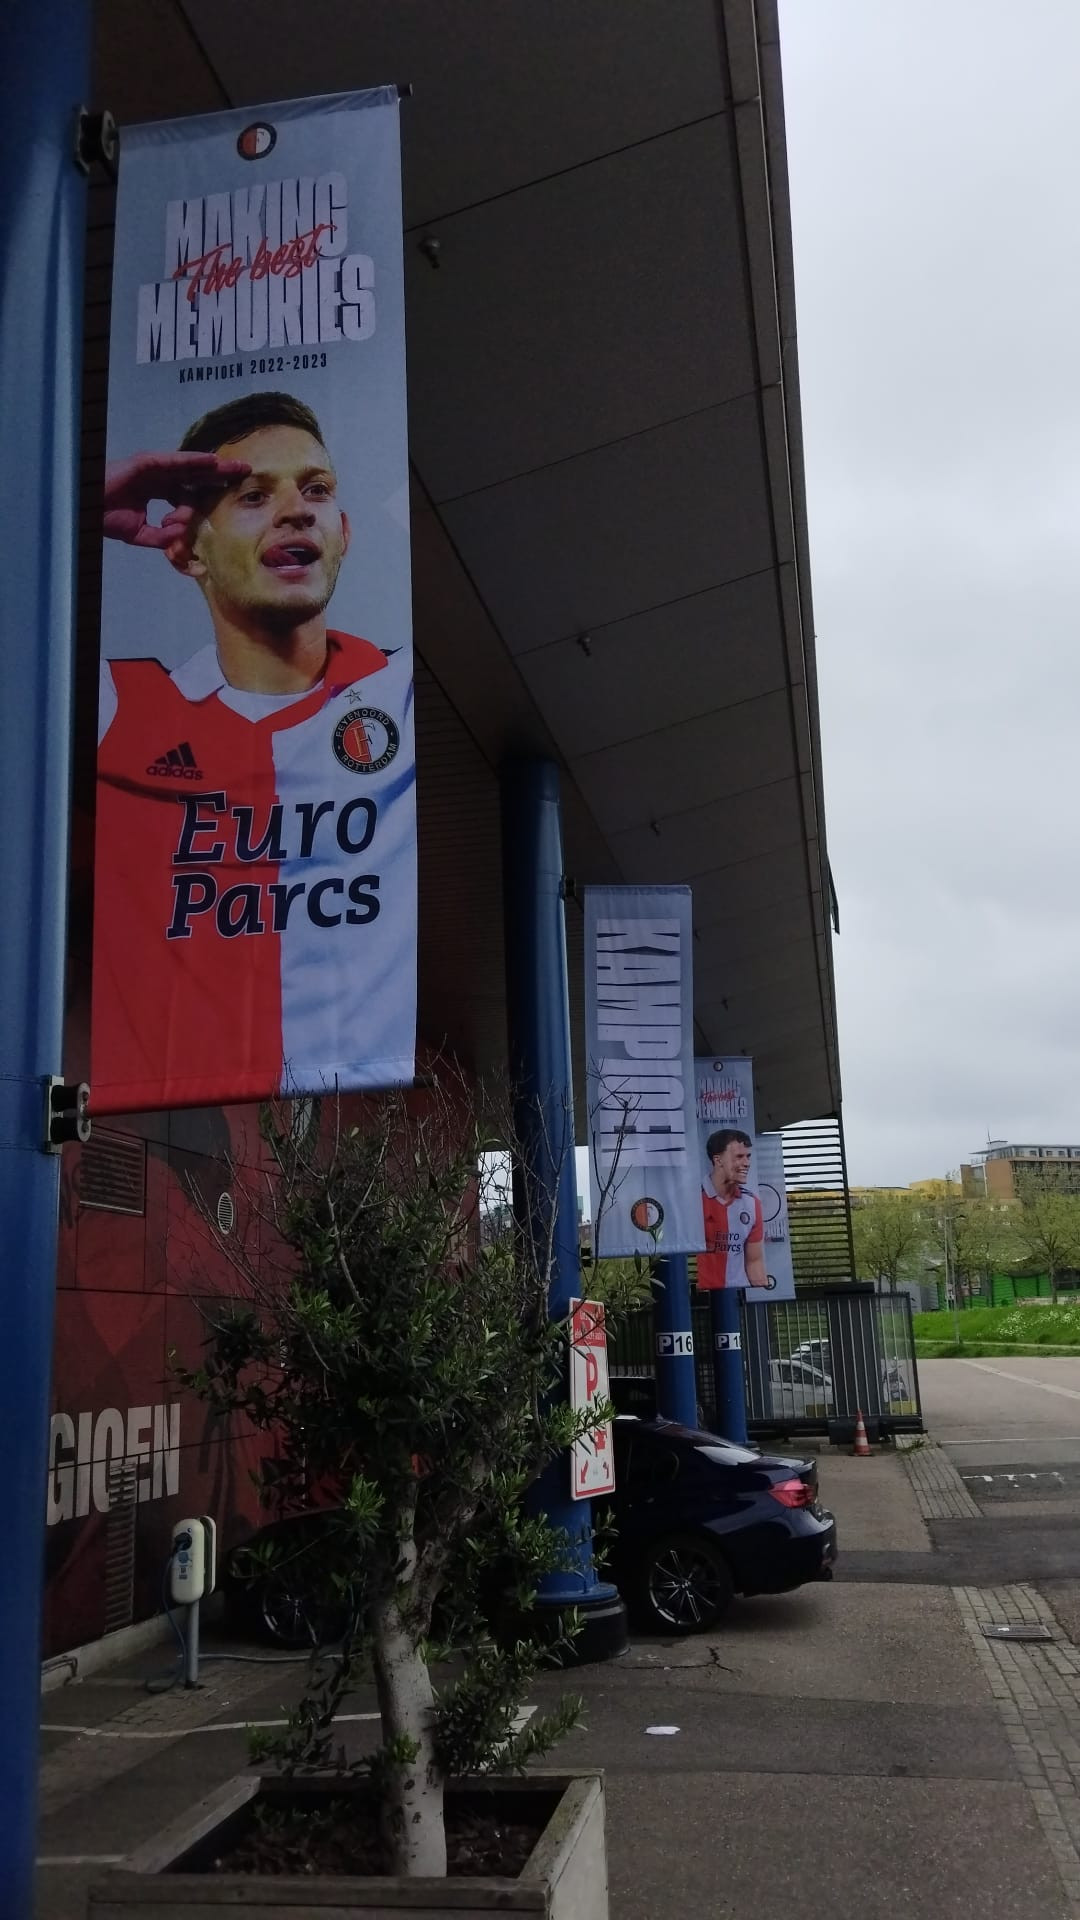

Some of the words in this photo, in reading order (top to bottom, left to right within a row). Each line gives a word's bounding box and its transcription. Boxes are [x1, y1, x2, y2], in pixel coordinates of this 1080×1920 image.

[165, 171, 348, 280] MAKING
[173, 242, 243, 302] The
[249, 223, 338, 280] best
[136, 254, 376, 365] MEMORIES
[250, 352, 328, 374] 2022-2023
[336, 709, 390, 738] FEYENOORD
[341, 742, 398, 771] ROTTERDAM
[145, 762, 204, 781] adidas
[172, 790, 378, 864] Euro
[165, 871, 381, 940] Parcs
[596, 918, 687, 1167] KAMPIOEN
